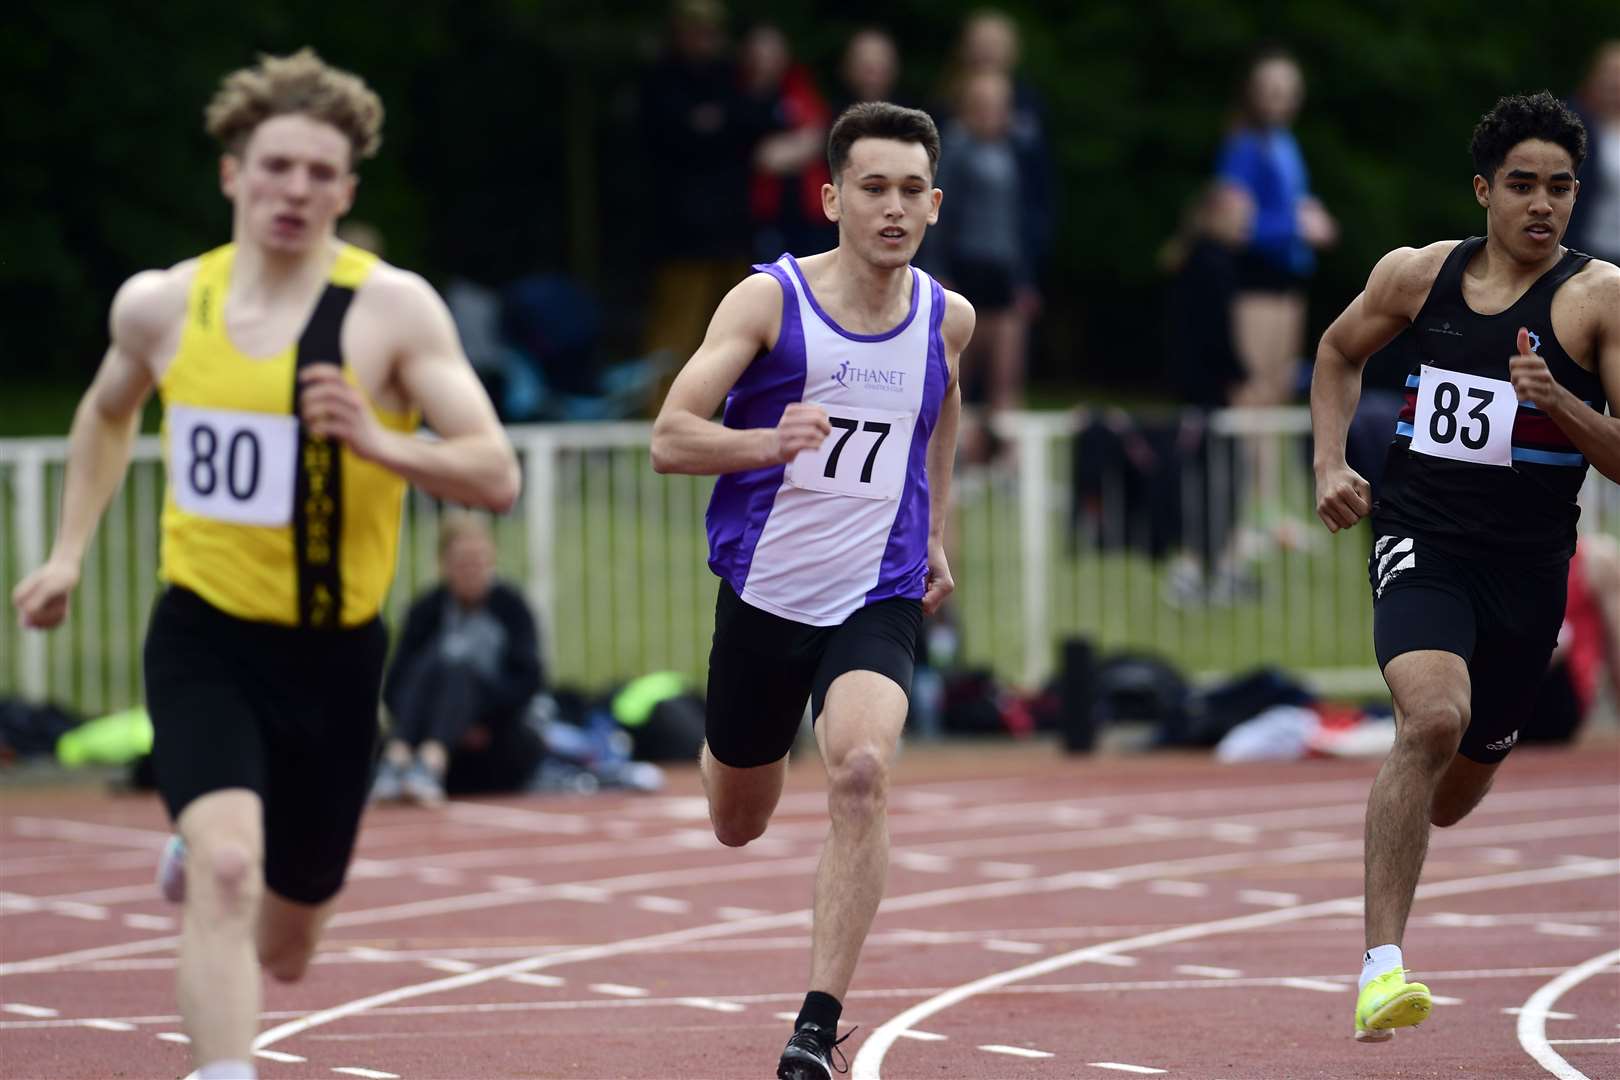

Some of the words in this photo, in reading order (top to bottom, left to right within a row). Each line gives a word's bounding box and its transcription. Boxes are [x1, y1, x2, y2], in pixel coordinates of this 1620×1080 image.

[848, 367, 906, 386] THANET
[1429, 381, 1495, 450] 83
[189, 423, 260, 502] 80
[823, 416, 892, 484] 77
